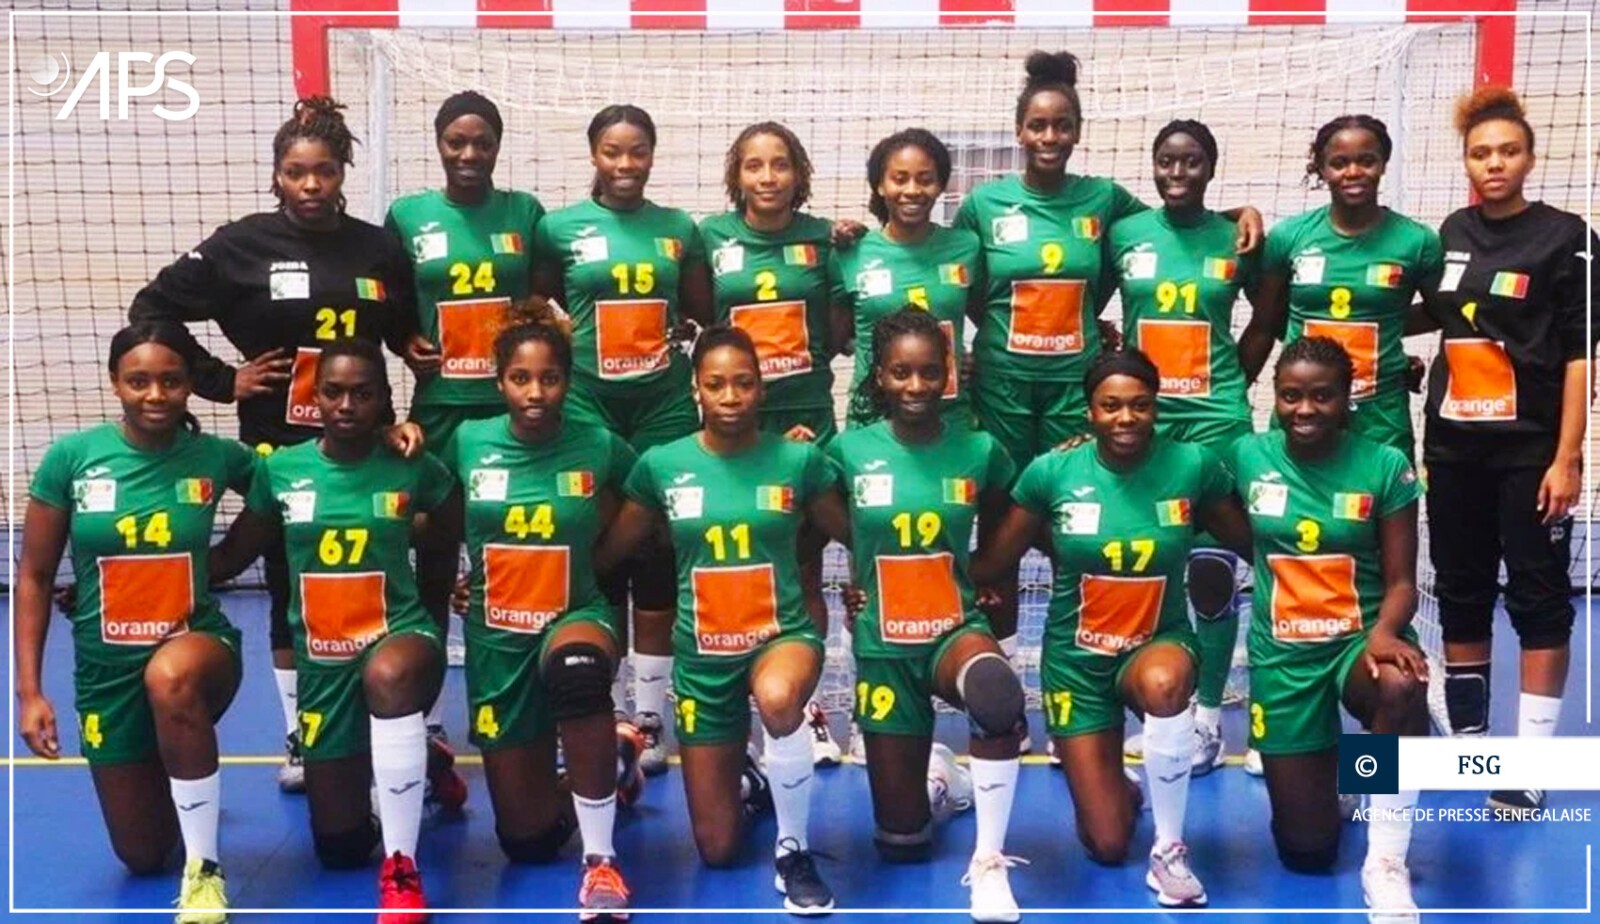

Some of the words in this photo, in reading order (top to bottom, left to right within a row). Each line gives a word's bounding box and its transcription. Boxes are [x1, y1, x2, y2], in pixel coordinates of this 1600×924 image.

[1042, 242, 1065, 274] 9
[449, 261, 496, 295] 24
[611, 262, 655, 294] 15
[755, 271, 778, 301] 2
[1156, 281, 1198, 314] 91
[1330, 286, 1352, 320] 8
[315, 308, 357, 340] 21
[1013, 333, 1075, 350] orange
[1159, 377, 1201, 393] ange
[116, 511, 172, 548] 14
[504, 504, 555, 539] 44
[891, 511, 942, 547] 19
[1296, 519, 1320, 552] 3
[318, 528, 369, 566] 67
[704, 523, 751, 561] 11
[1102, 539, 1156, 572] 17
[886, 616, 956, 637] orange
[1278, 616, 1352, 635] orange
[856, 681, 896, 721] 19
[1251, 703, 1266, 738] 3
